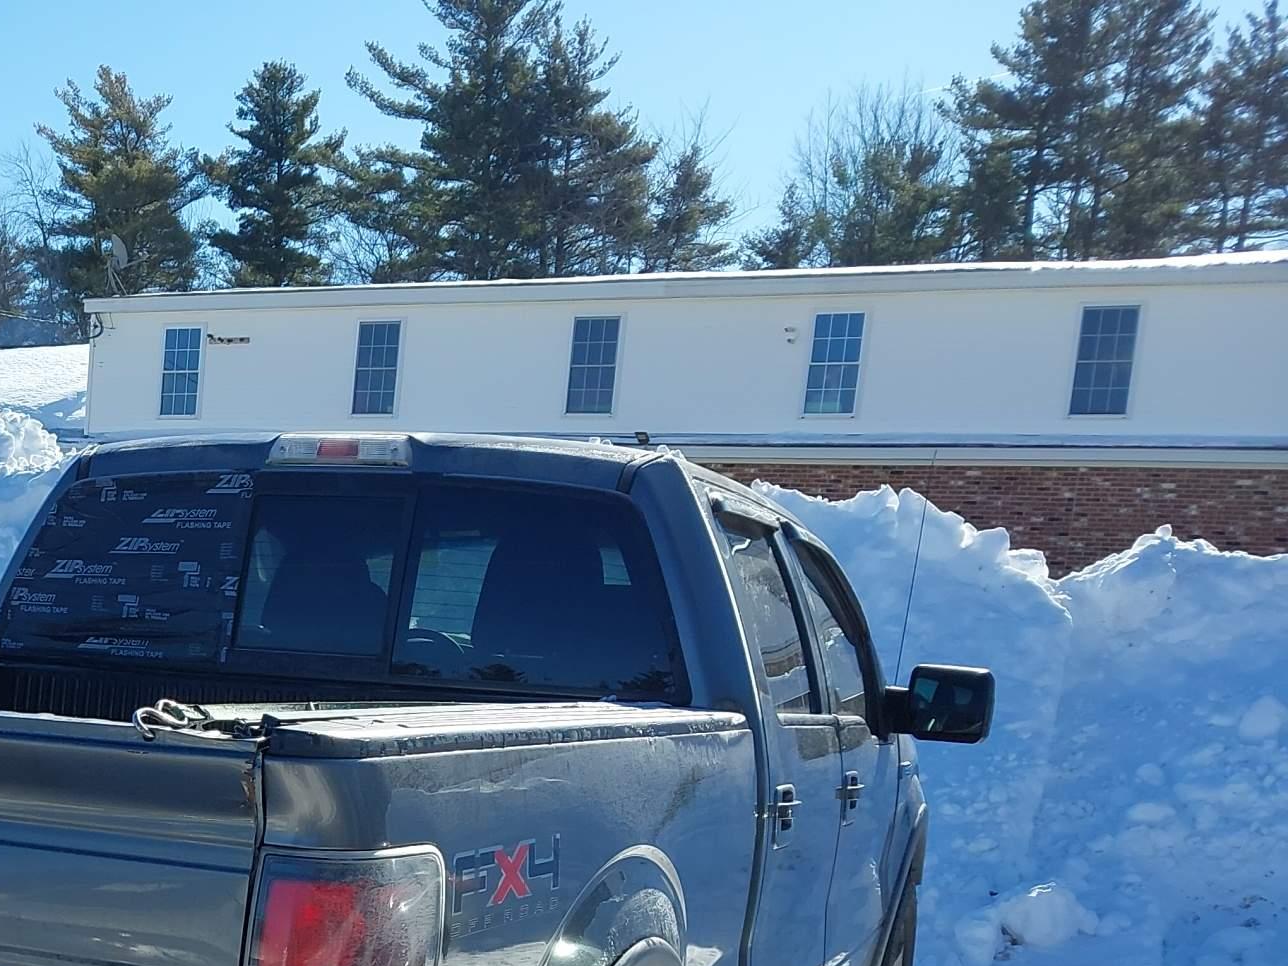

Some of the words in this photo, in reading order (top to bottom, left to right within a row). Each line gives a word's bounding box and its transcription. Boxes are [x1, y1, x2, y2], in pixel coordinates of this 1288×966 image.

[176, 521, 212, 529] FLASHING
[213, 521, 232, 529] TAPE
[74, 577, 106, 585] FLASHING
[110, 577, 126, 585] TAPE
[51, 606, 68, 614] TAPE
[110, 649, 144, 657] FLASHING
[452, 833, 560, 916] FX4
